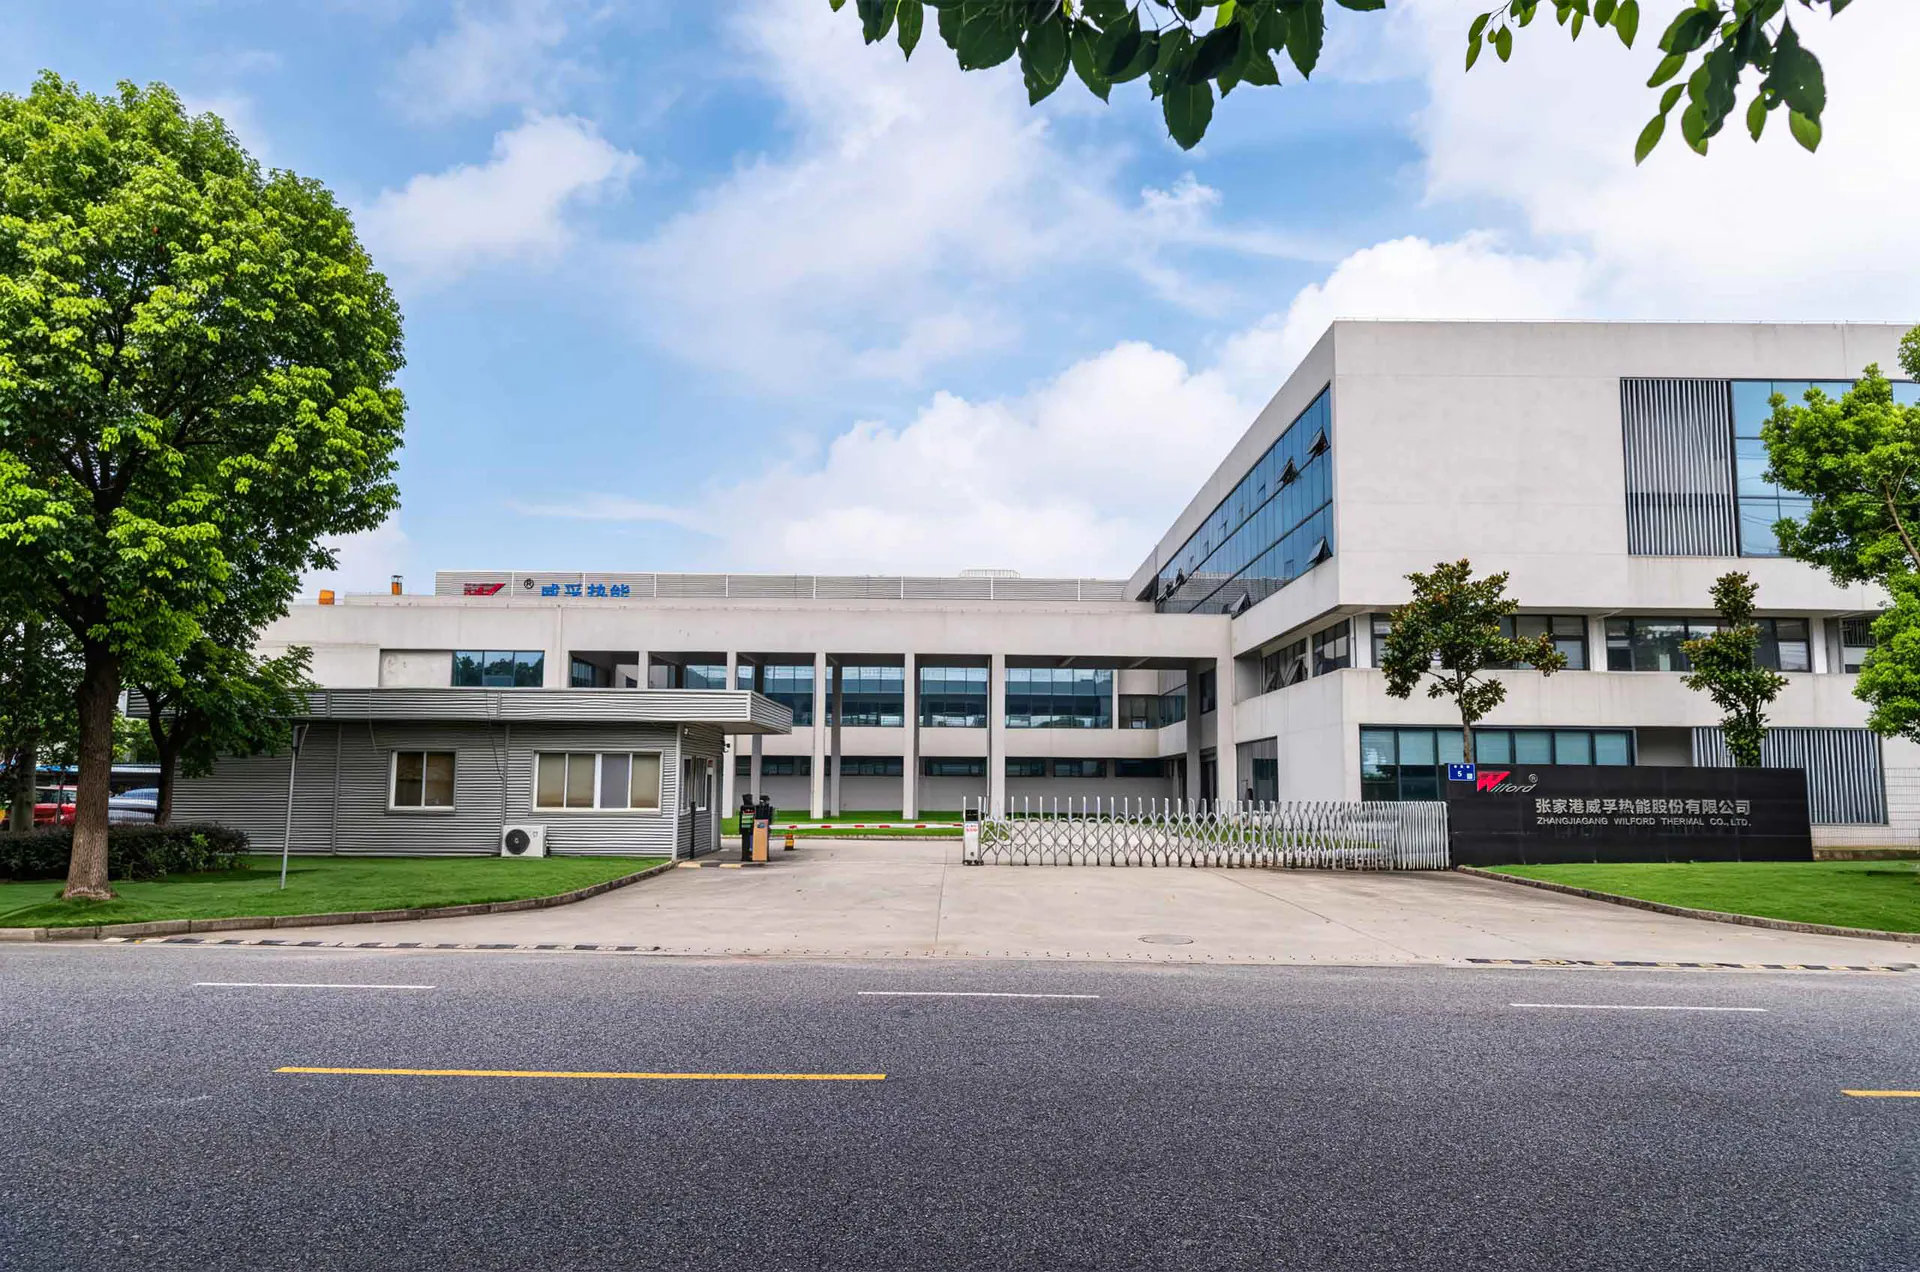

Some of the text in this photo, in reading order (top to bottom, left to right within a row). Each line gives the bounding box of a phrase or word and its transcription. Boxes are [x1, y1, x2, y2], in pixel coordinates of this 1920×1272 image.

[1476, 770, 1537, 793] Wilford
[1535, 798, 1750, 815] 张家港威孚热能股份有限公司
[1536, 816, 1608, 825] ZHANGJIAGANG
[1613, 817, 1656, 826] WILFORD
[1660, 817, 1704, 826] THERMAL
